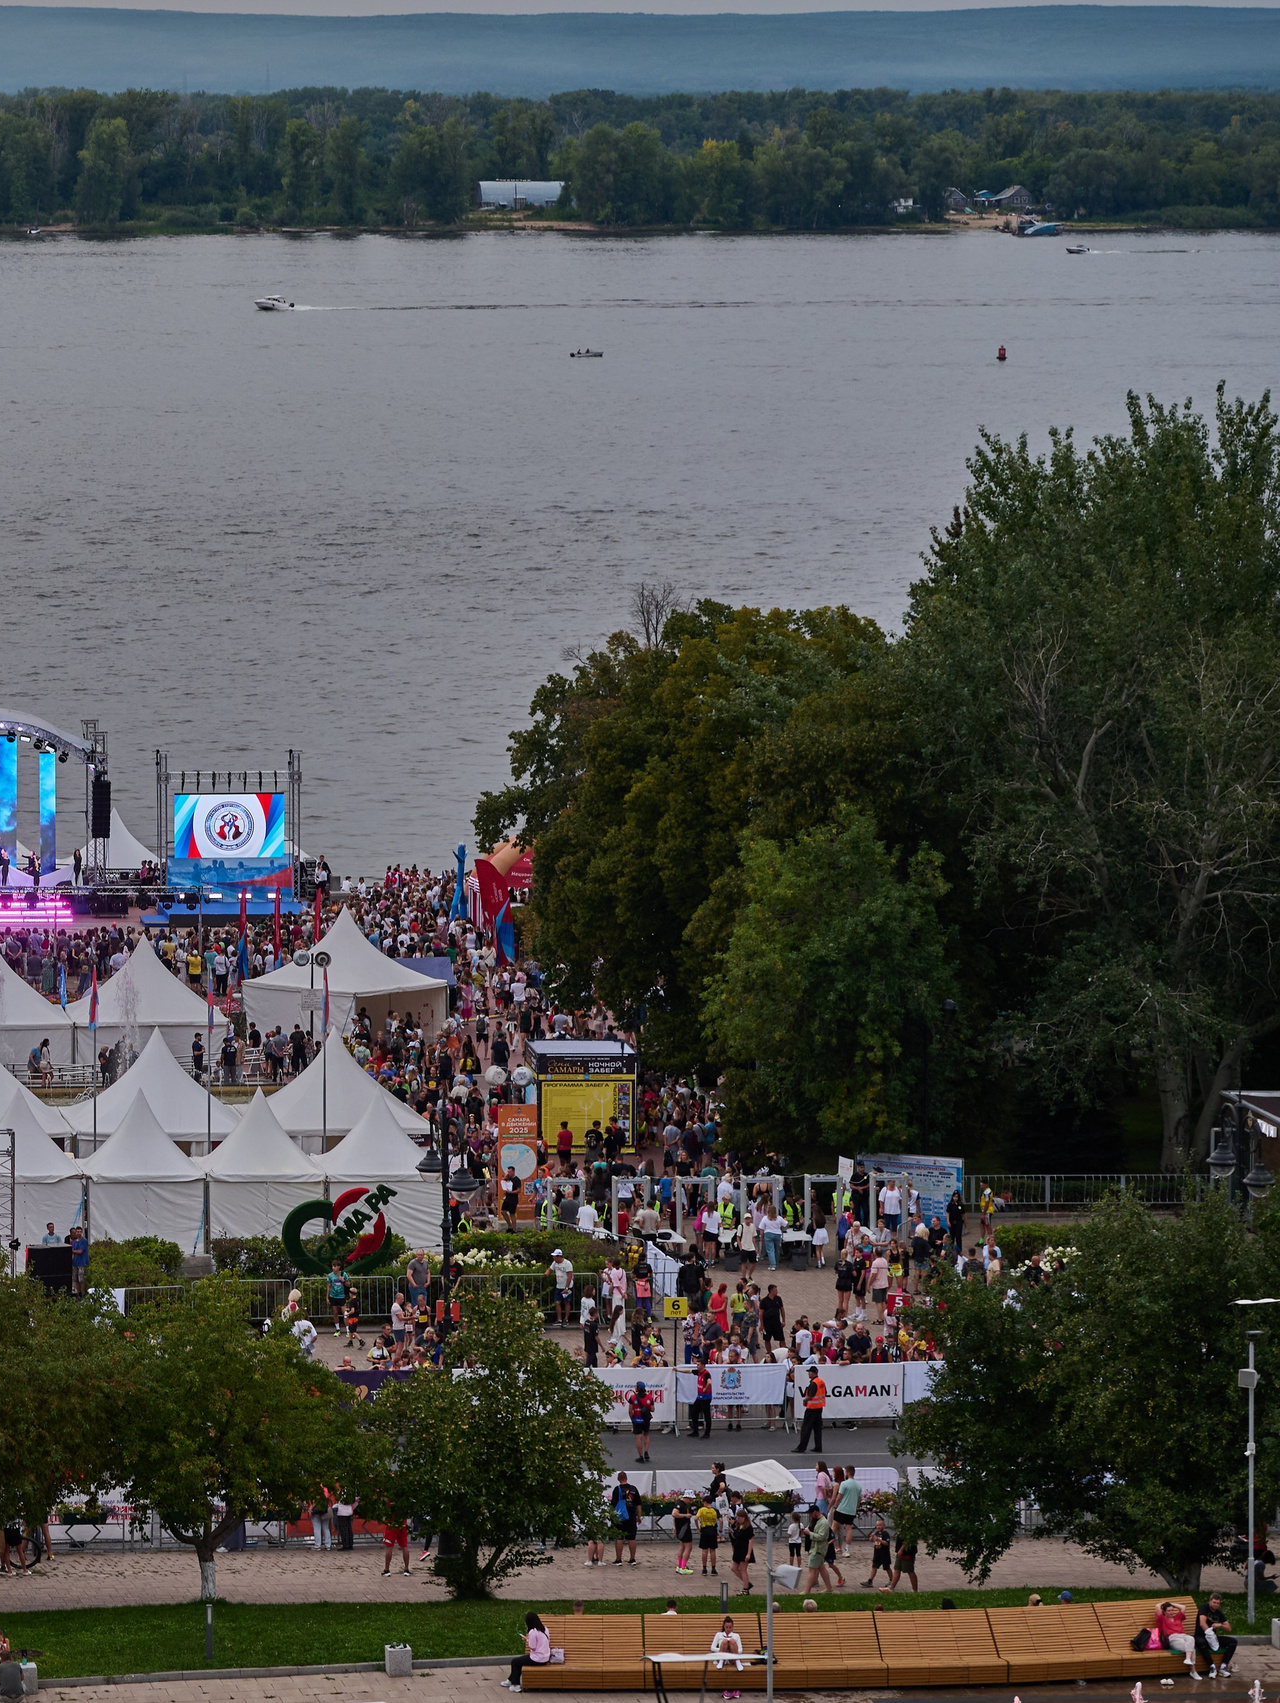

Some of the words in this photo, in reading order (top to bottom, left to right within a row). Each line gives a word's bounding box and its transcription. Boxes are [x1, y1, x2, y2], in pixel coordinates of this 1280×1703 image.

[588, 1060, 622, 1068] НОЧНОЙ
[547, 1066, 585, 1074] САМАРЫ
[316, 1184, 398, 1260] САМАРА
[671, 1299, 681, 1311] 6
[894, 1296, 904, 1307] 5
[798, 1384, 891, 1398] VLGAMAN
